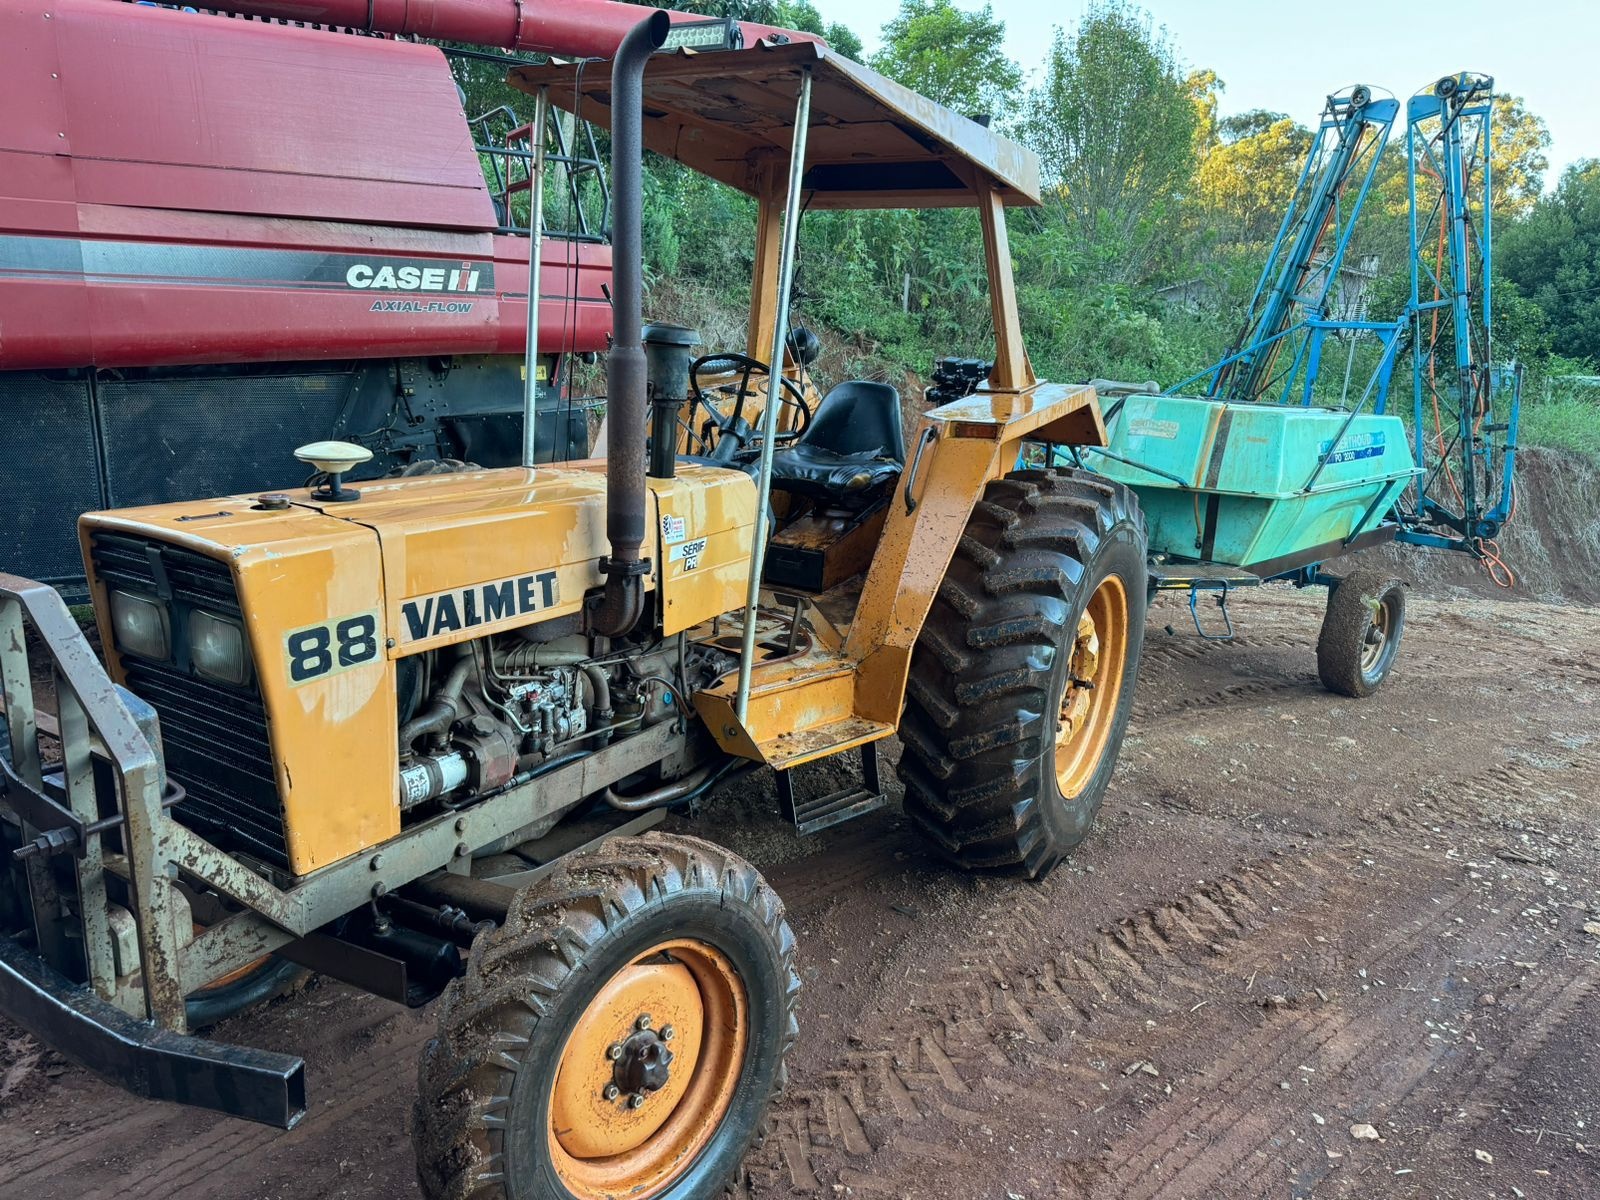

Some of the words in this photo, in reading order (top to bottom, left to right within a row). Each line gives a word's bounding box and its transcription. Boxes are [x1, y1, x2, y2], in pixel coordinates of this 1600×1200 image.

[346, 264, 445, 290] CASE
[369, 300, 473, 313] AXIAL-FLOW
[1344, 451, 1355, 461] 2000
[401, 571, 557, 641] VALMET
[288, 614, 377, 682] 88
